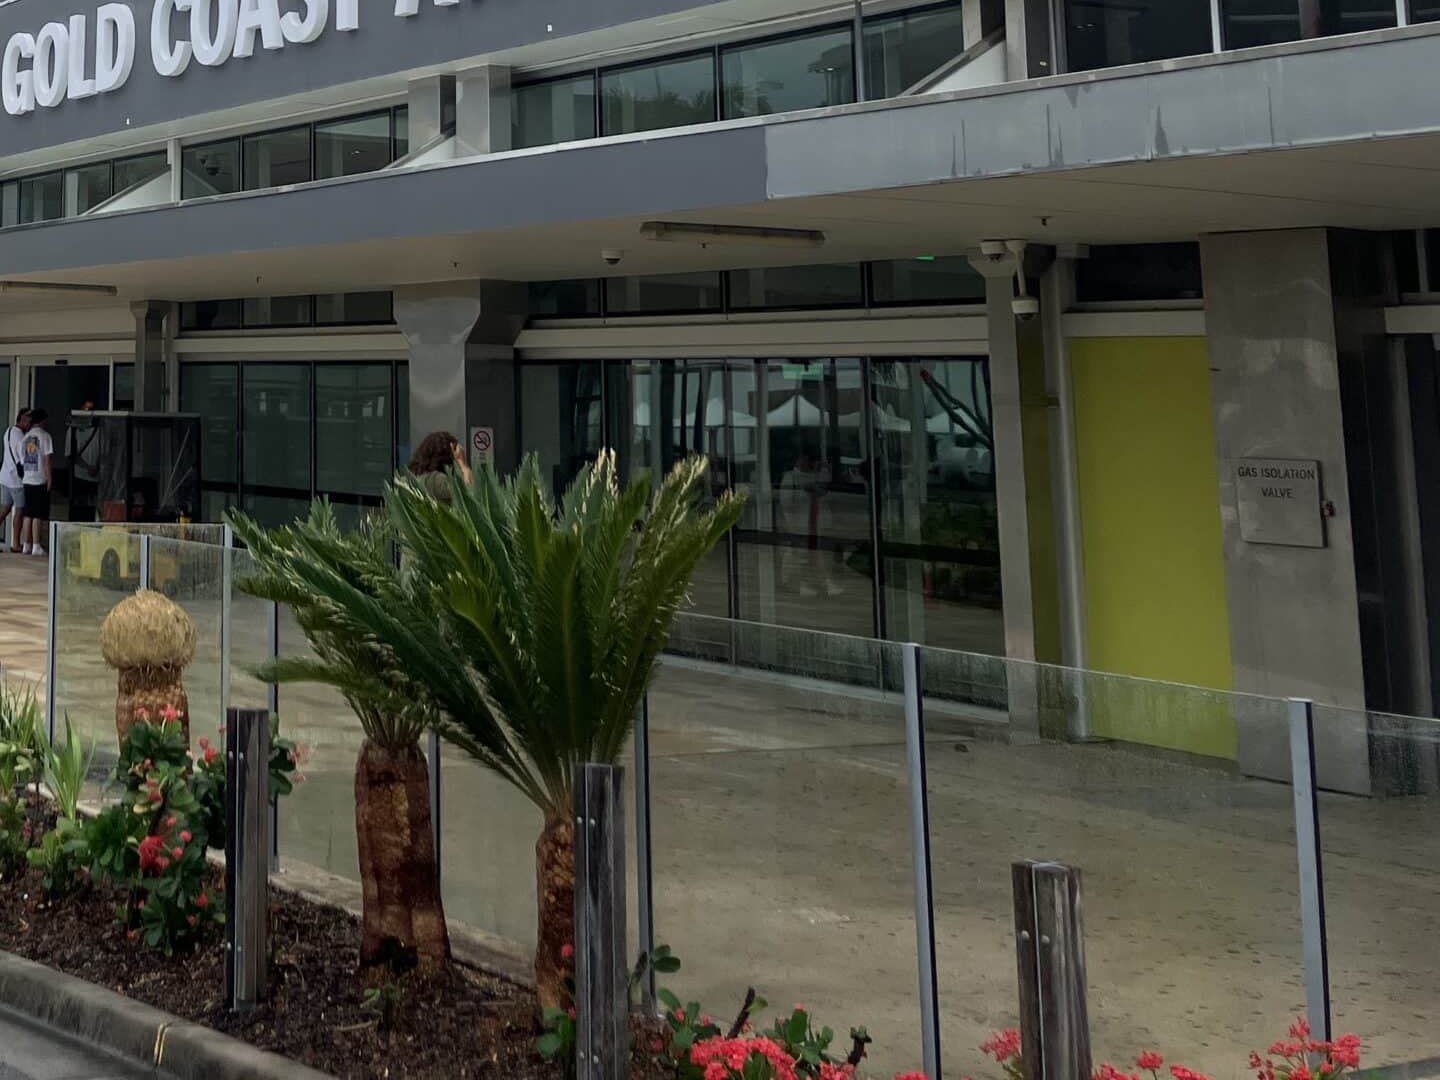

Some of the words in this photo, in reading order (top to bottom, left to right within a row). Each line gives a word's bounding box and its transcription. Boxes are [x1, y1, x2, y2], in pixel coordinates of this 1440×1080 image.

[1, 2, 135, 116] GOLD
[1238, 465, 1258, 478] GAS
[1260, 467, 1315, 480] ISOLATION
[1261, 487, 1294, 498] VALVE
